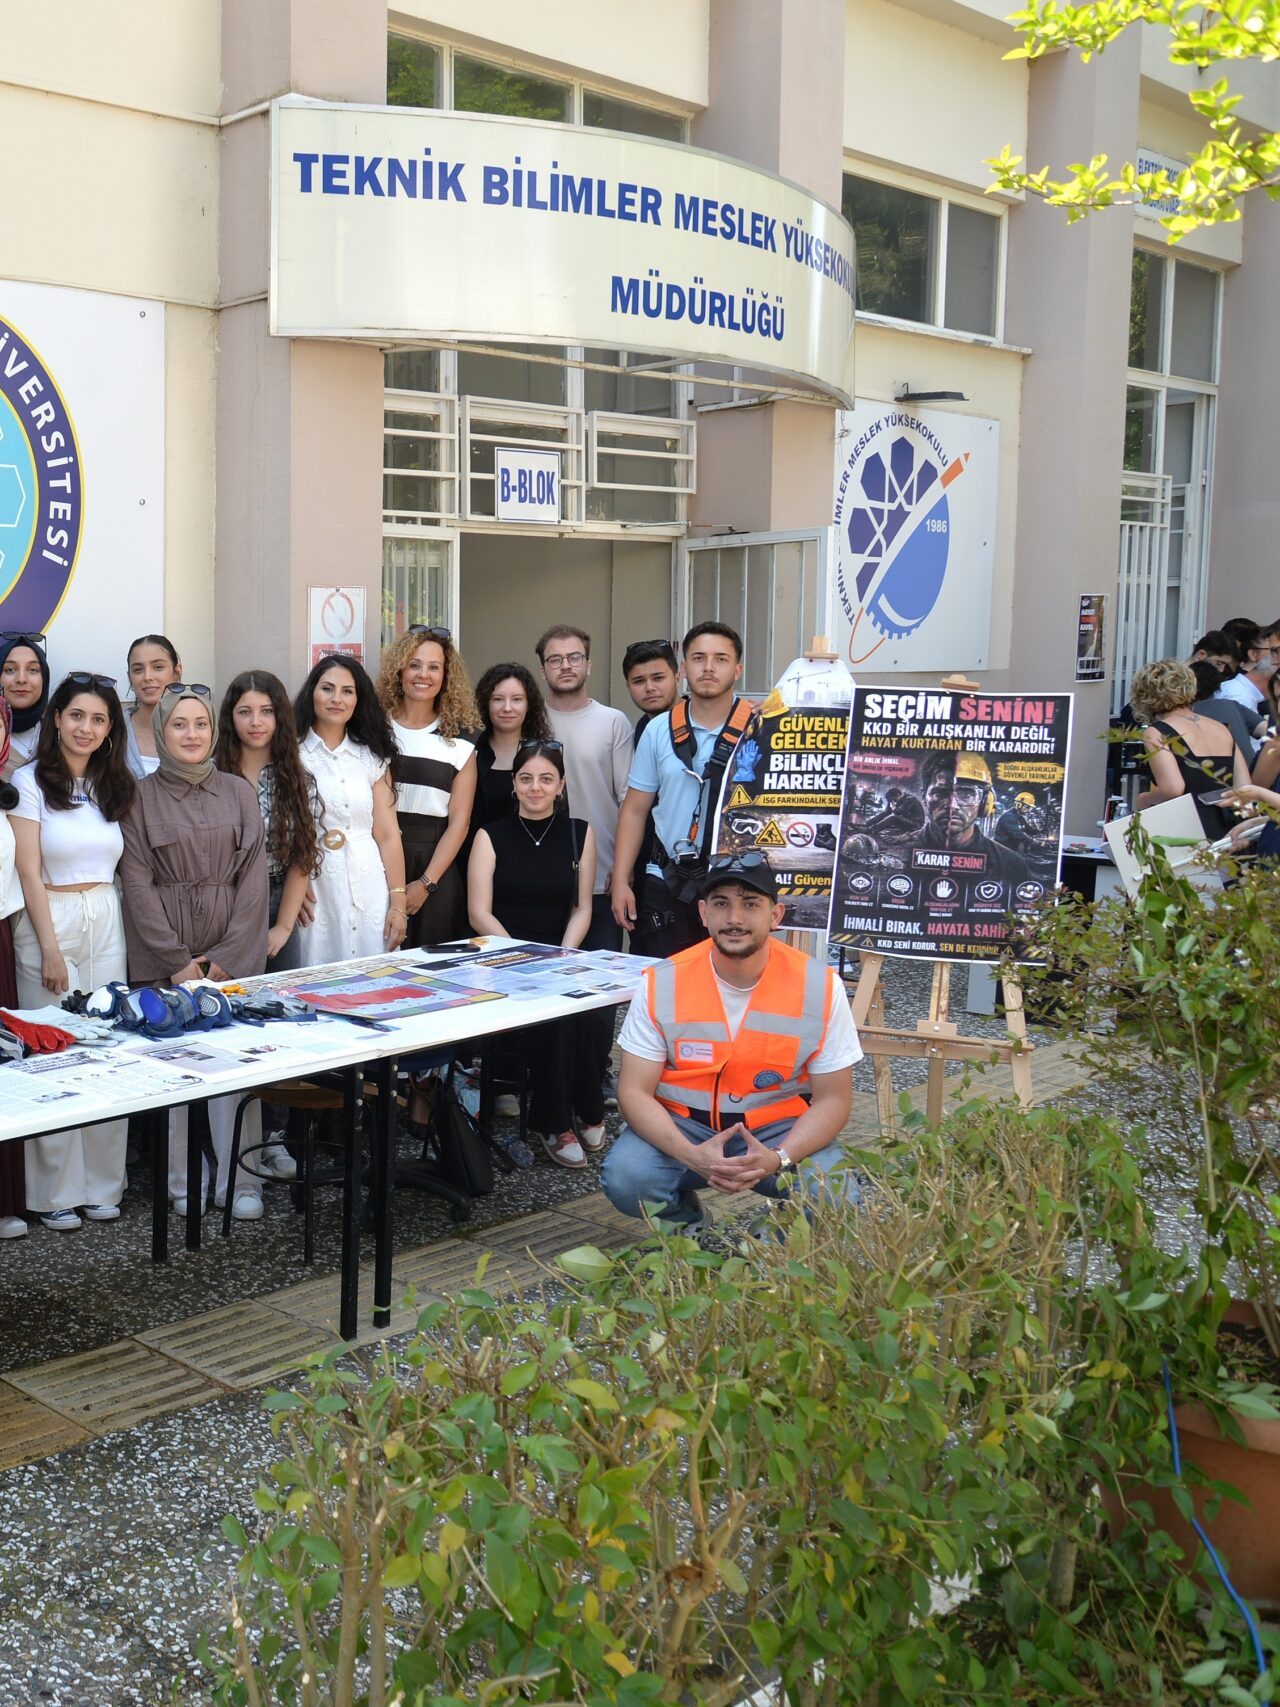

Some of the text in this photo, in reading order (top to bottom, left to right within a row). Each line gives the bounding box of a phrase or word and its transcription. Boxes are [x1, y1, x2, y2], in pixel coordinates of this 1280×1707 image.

[293, 147, 467, 202] TEKNİK
[482, 157, 663, 226] BİLİMLER
[674, 192, 777, 253] MESLEK
[611, 269, 785, 342] MÜDÜRLÜĞÜ
[833, 470, 850, 526] İMLER
[848, 416, 882, 469] MESLEK
[884, 412, 948, 468] YÜKSEKOKULU
[500, 467, 556, 506] B-BLOK
[926, 519, 947, 533] 1986
[864, 692, 1055, 724] SEÇİM SENİN!
[863, 721, 1056, 741] KKD BİR ALIŞKANLIK DEĞİL,
[861, 736, 1055, 754] HAYAT KURTARAN BİR KARARDIR!
[917, 853, 983, 869] KARAR SENİN!
[844, 916, 882, 931] İHMALİ
[886, 920, 924, 936] BIRAK,
[927, 923, 970, 936] HAYATA
[877, 939, 892, 948] KKD
[893, 938, 911, 949] SENİ
[912, 941, 938, 951] KORUR,
[939, 944, 954, 953] SEN
[956, 944, 966, 953] DE
